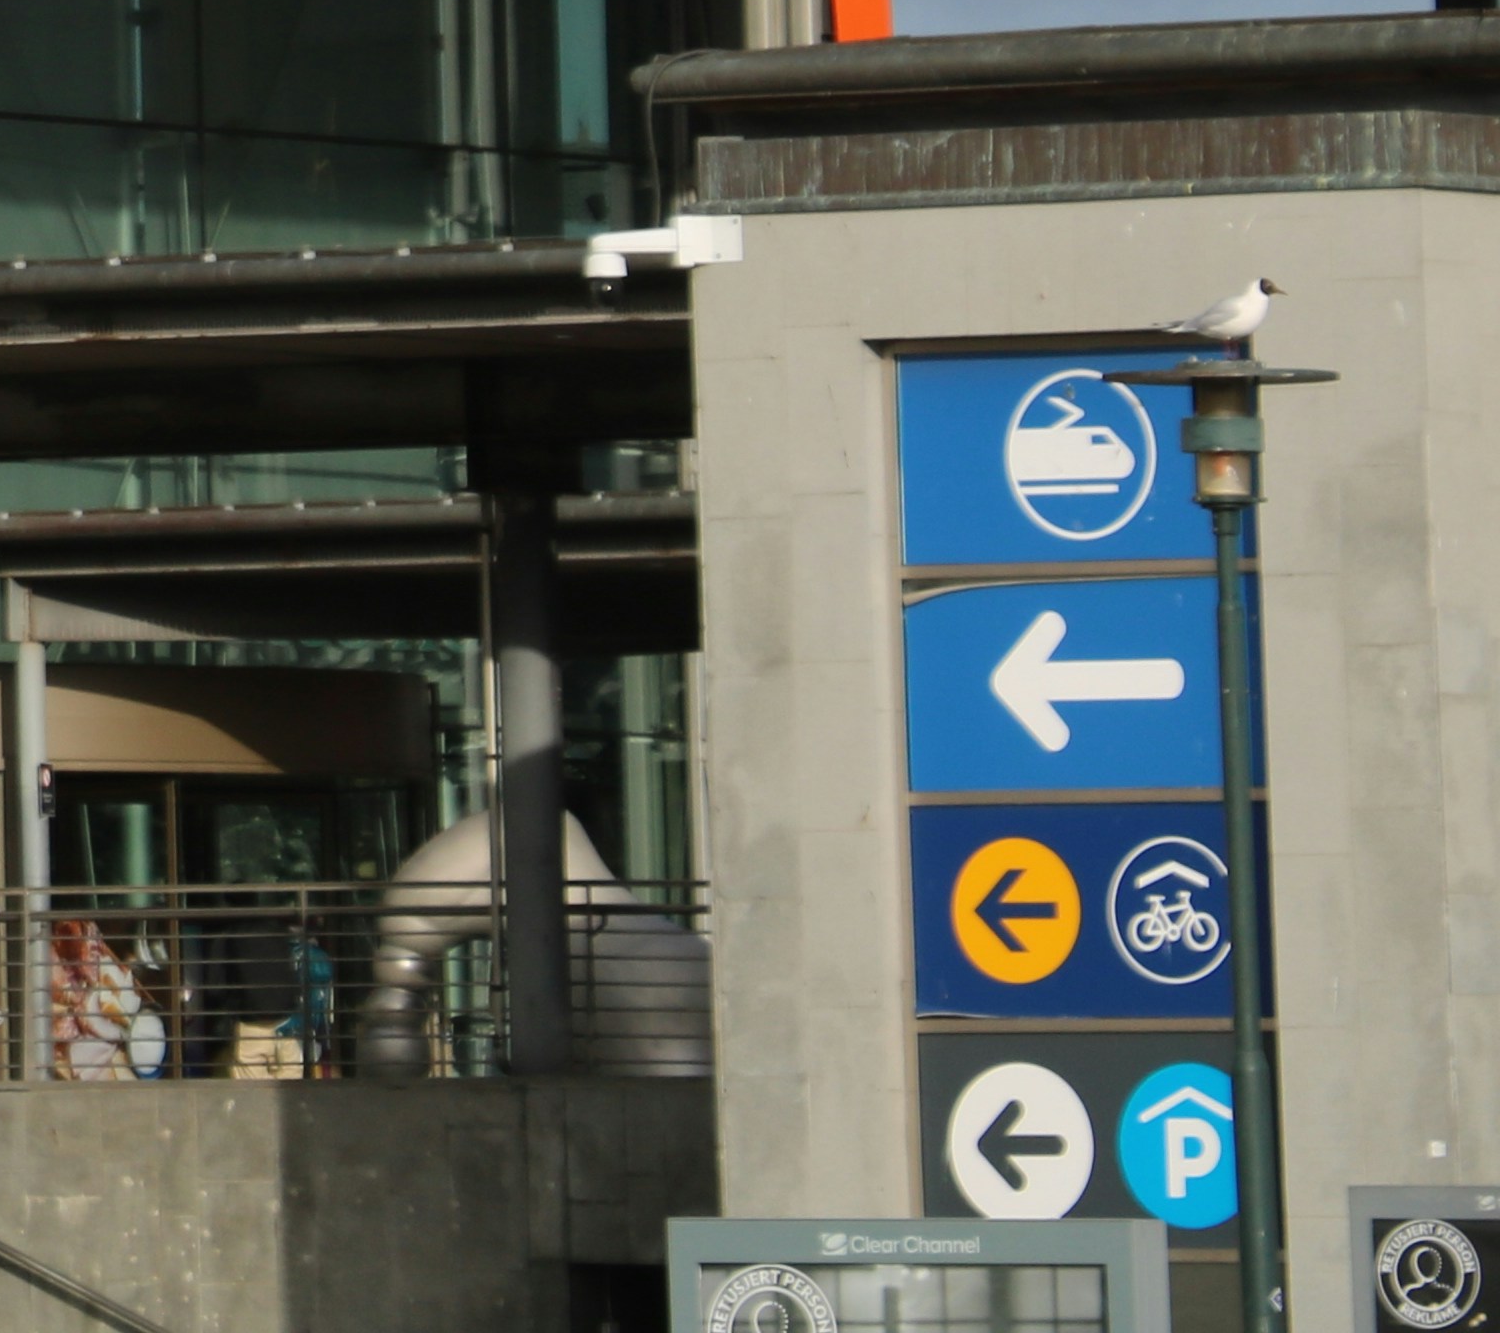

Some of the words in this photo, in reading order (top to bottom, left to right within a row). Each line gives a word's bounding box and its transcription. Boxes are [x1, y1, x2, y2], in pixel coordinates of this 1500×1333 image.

[1164, 1117, 1223, 1200] P
[850, 1235, 900, 1254] Clear
[904, 1235, 980, 1254] Channel
[1381, 1223, 1436, 1273] RETUSJERT
[1436, 1226, 1477, 1274] PERSON
[1401, 1302, 1462, 1325] REKLAME
